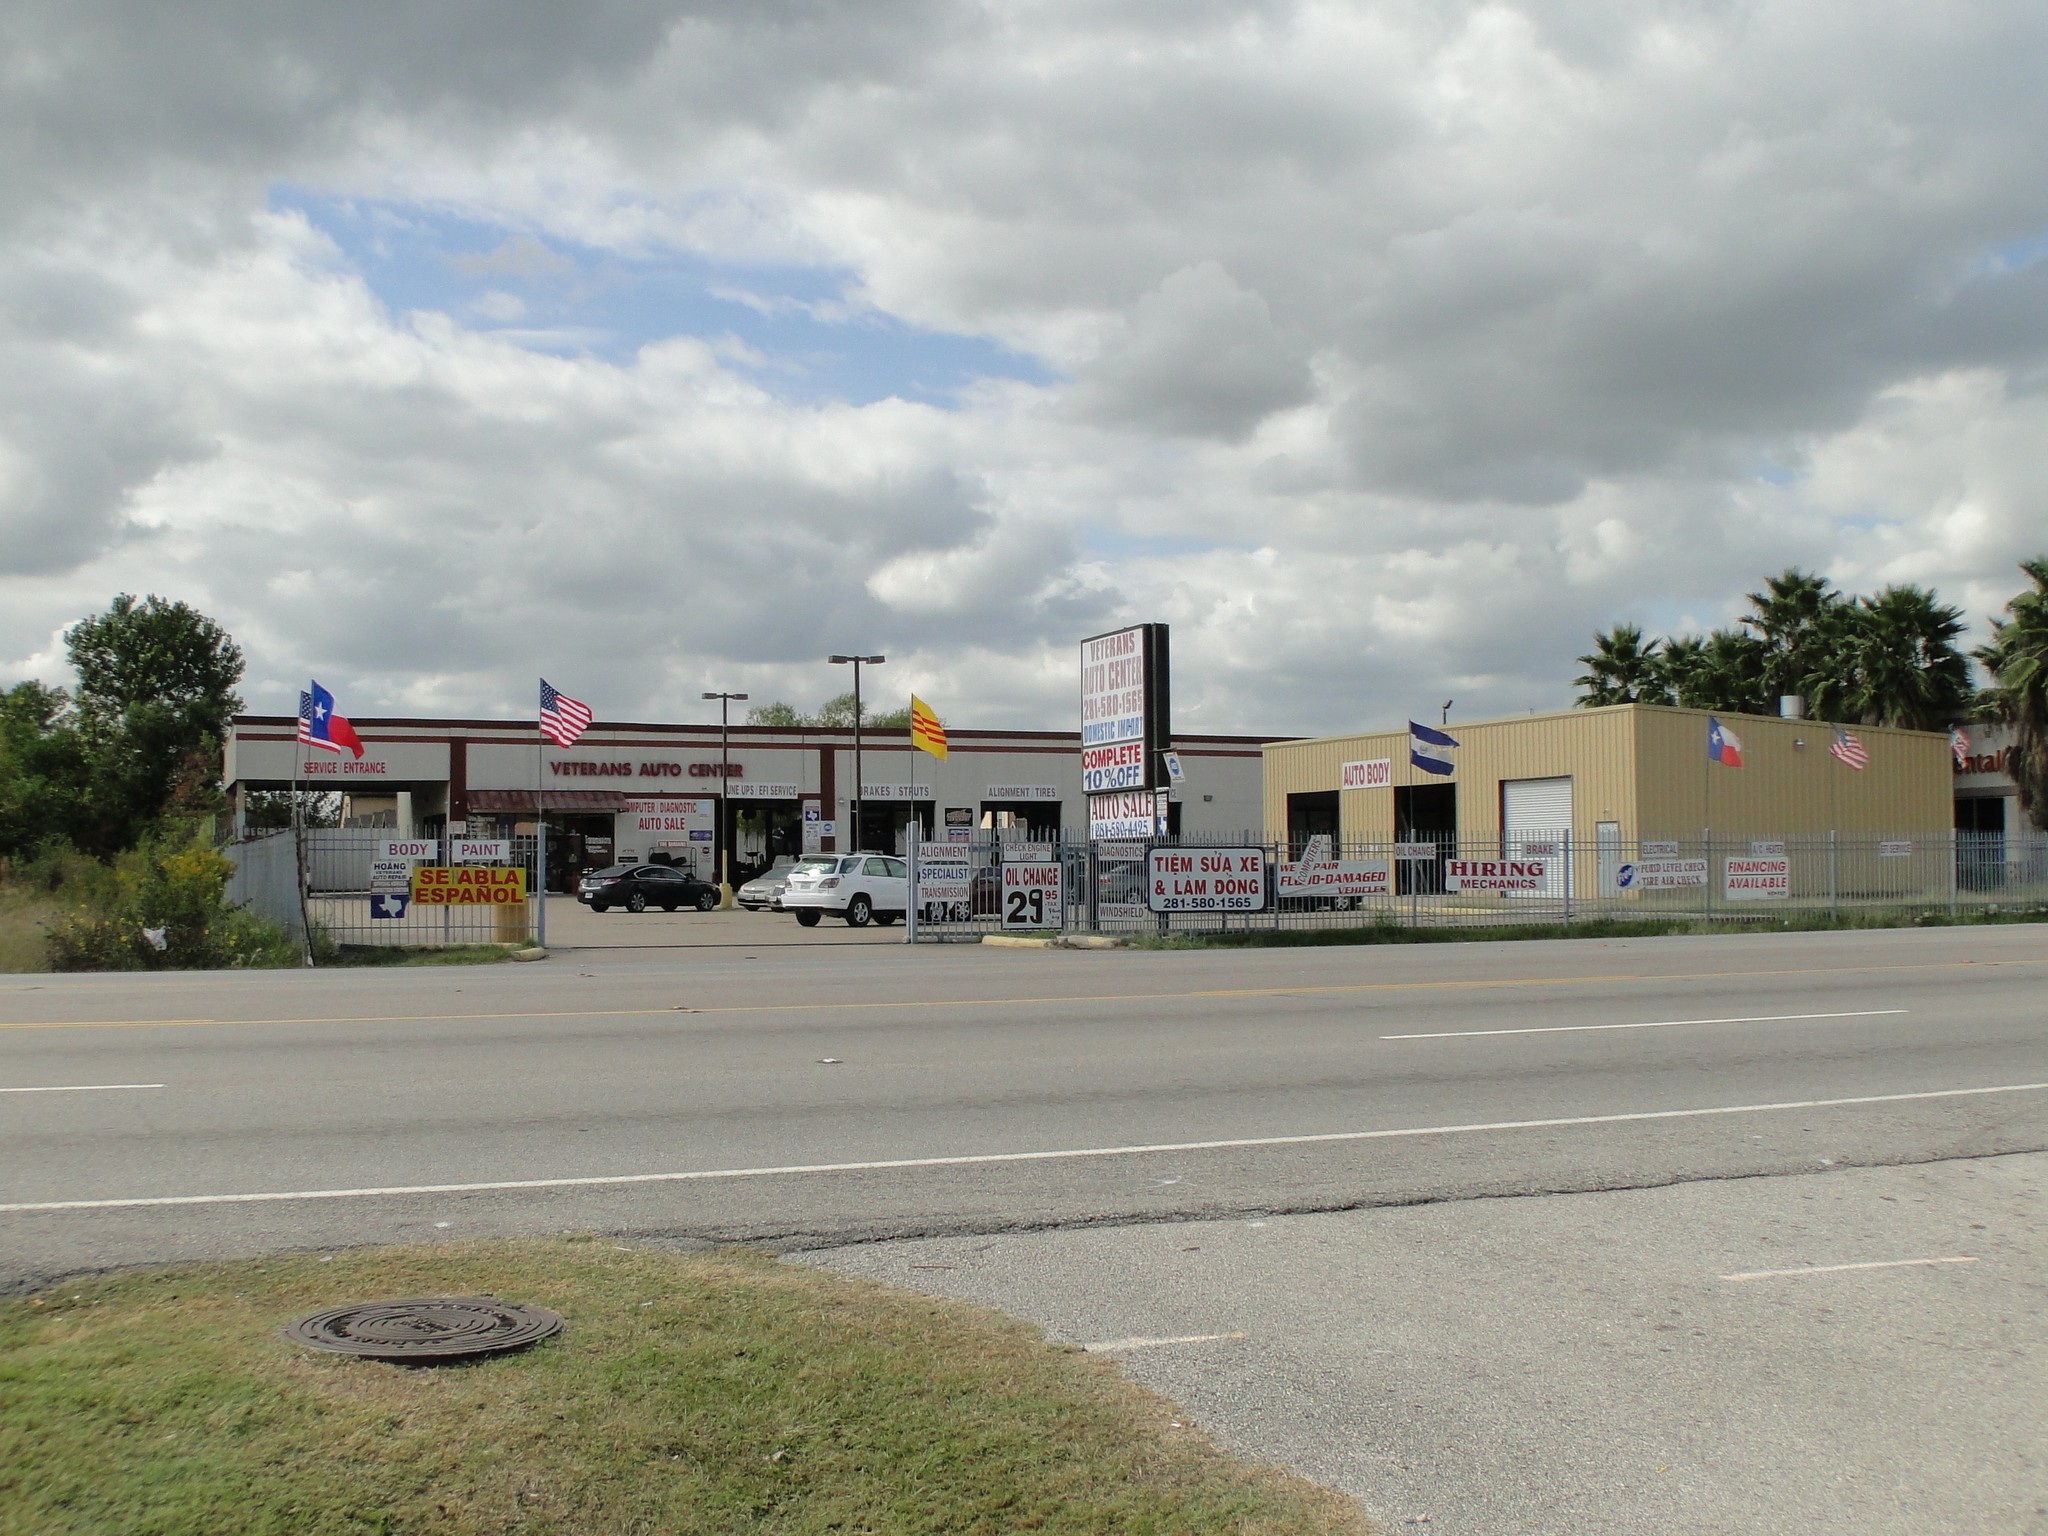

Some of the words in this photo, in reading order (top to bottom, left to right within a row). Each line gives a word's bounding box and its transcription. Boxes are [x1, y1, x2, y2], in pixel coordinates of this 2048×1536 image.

[1090, 632, 1135, 661] VETERANS
[1084, 664, 1104, 695] AUTO
[1108, 655, 1142, 690] CENTER
[1084, 689, 1142, 720] 281-580-1565
[1084, 721, 1115, 743] DOMESTIC
[1118, 716, 1142, 738] IMPORT
[1082, 744, 1141, 769] COMPLETE
[304, 761, 337, 774] SERVICE
[344, 761, 386, 774] ENTRANCE
[550, 761, 632, 776] VETERANS
[639, 763, 682, 777] AUTO
[688, 763, 743, 778] CENTER
[1344, 764, 1365, 786] AUTO
[1367, 762, 1389, 784] BODY
[741, 785, 754, 795] UPS
[759, 785, 768, 795] EFI
[770, 785, 797, 796] SERVICE
[899, 786, 929, 796] STRUTS
[989, 787, 1030, 797] ALIGNMENT
[1035, 787, 1056, 797] TIRES
[660, 802, 697, 813] DIAGNOSTIC
[1092, 794, 1119, 820] AUTO
[1123, 791, 1151, 818] SALE
[639, 817, 661, 830] AUTO
[664, 817, 685, 830] SALE
[389, 843, 428, 856] BODY
[461, 844, 500, 856] PAINT
[921, 846, 967, 857] ALIGNMENT
[1006, 844, 1026, 852] CHECK
[1028, 844, 1050, 852] ENGINE
[1100, 846, 1143, 857] DIAGNOSTICS
[1396, 846, 1406, 856] OIL
[1408, 846, 1435, 856] CHANGE
[1526, 845, 1554, 854] BRAKE
[1643, 845, 1677, 854] ELECTRICAL
[1154, 853, 1192, 875] TIỆM
[1240, 857, 1259, 872] XE
[1298, 838, 1321, 883] COMPUTERS
[1280, 864, 1296, 872] WE
[1450, 861, 1544, 877] HIRING
[1663, 863, 1682, 873] LEVEL
[1684, 862, 1706, 872] CHECK
[1728, 861, 1786, 872] FINANCING
[420, 869, 449, 884] SE
[457, 869, 520, 884] ABLA
[922, 868, 968, 879] SPECIALIST
[1005, 867, 1019, 886] OIL
[1023, 867, 1058, 886] CHANGE
[1460, 880, 1537, 889] MECHANICS
[1641, 876, 1659, 886] TIRE
[1662, 876, 1675, 886] AIR
[1677, 875, 1702, 885] CHECK
[1728, 877, 1786, 888] AVAILABLE
[921, 887, 968, 898] TRANSMISSION
[1155, 880, 1165, 895] &
[1338, 885, 1386, 895] VEHICLES
[415, 885, 523, 903] ESPAÑOL
[1007, 889, 1043, 924] 29
[1044, 890, 1058, 900] 95
[1163, 897, 1251, 908] 281-580-1565
[1100, 907, 1144, 918] WINDSHIELD
